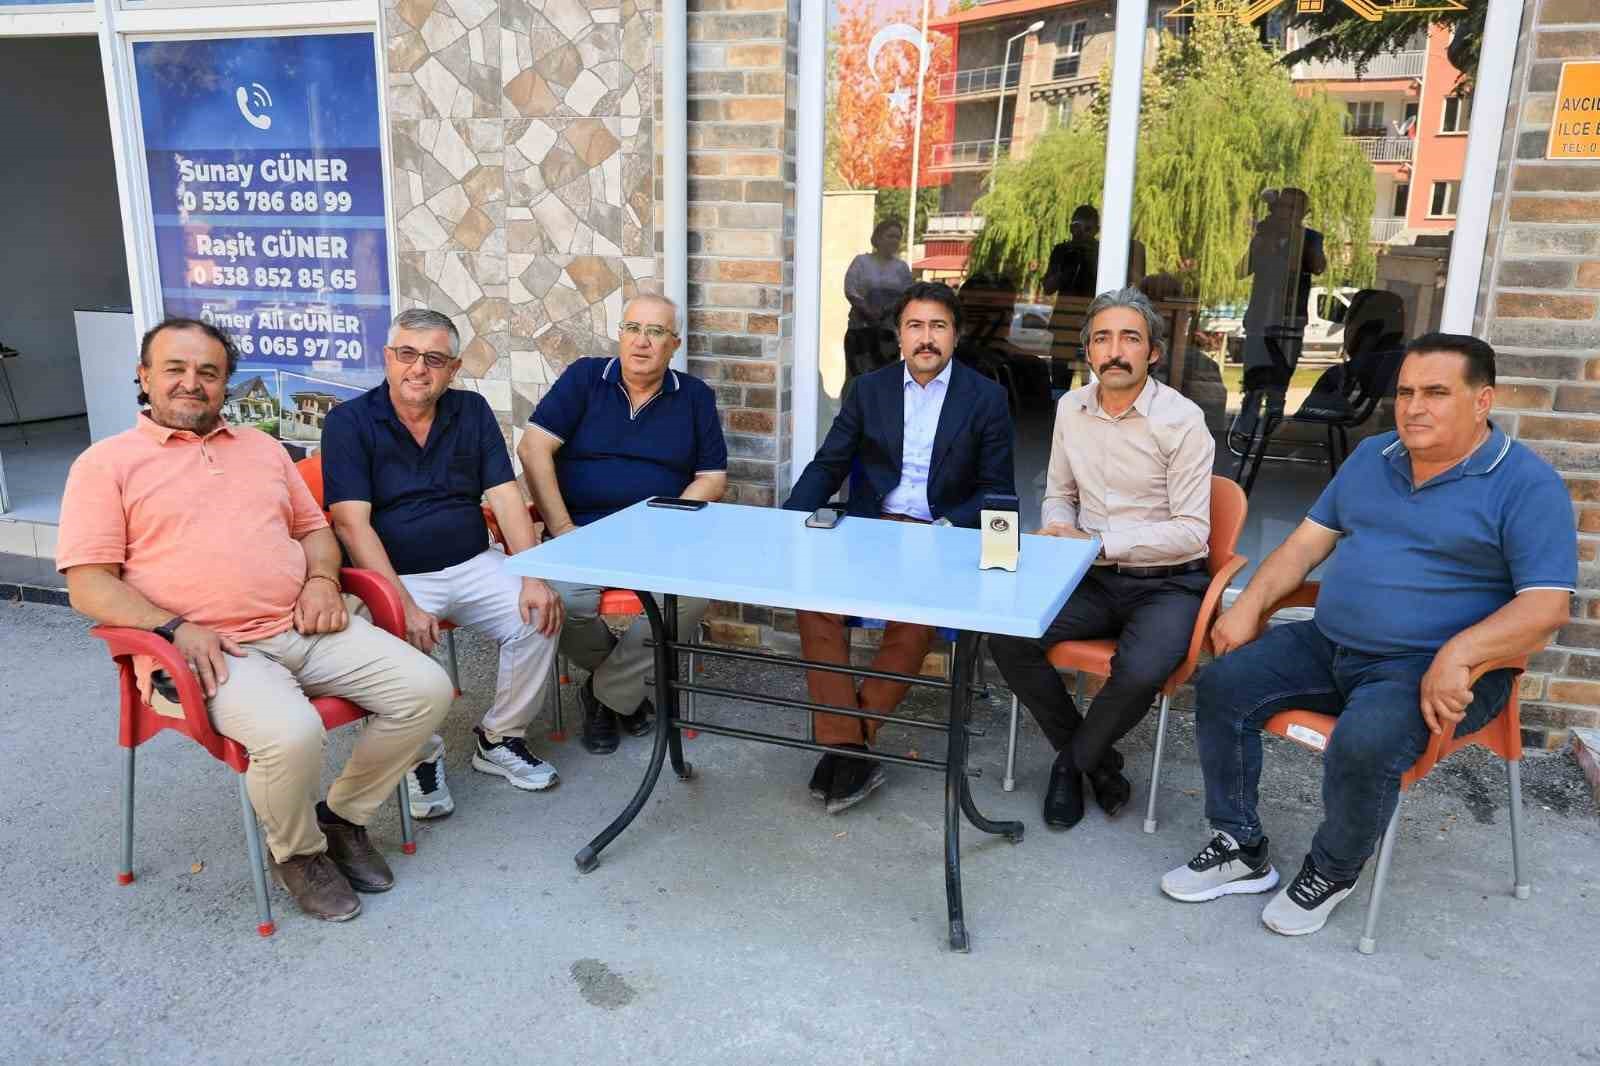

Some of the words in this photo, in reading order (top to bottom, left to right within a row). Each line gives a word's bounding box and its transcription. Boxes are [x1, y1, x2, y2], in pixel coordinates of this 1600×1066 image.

[181, 159, 253, 187] Sunay
[260, 152, 348, 182] GÜNER
[183, 191, 196, 211] 0
[202, 191, 240, 212] 536
[244, 191, 285, 212] 786
[290, 191, 319, 212] 88
[323, 191, 352, 212] 99
[196, 231, 256, 263] Raşit
[261, 229, 349, 259] GÜNER
[194, 266, 206, 284] 0
[212, 266, 249, 286] 538
[254, 267, 292, 288] 852
[298, 268, 325, 289] 85
[330, 269, 357, 289] 65
[200, 303, 253, 329] Ömer
[258, 311, 284, 330] Ali
[259, 335, 298, 356] 065
[303, 338, 329, 358] 97
[335, 340, 362, 360] 20
